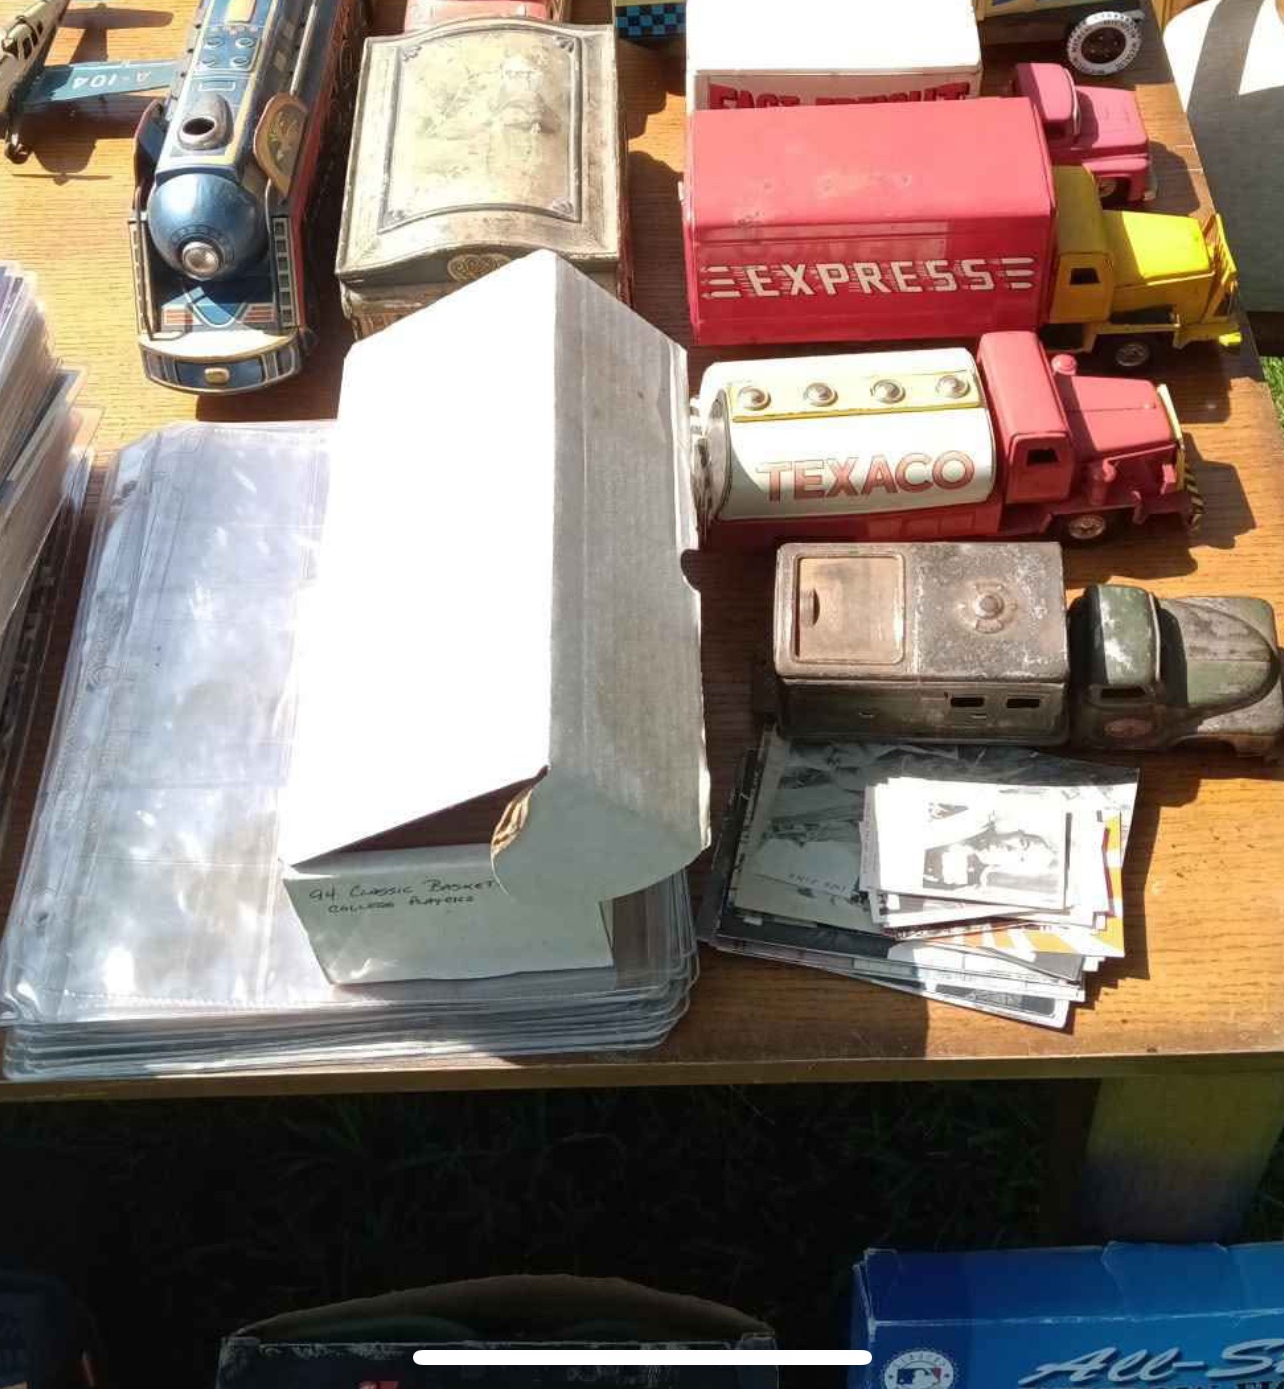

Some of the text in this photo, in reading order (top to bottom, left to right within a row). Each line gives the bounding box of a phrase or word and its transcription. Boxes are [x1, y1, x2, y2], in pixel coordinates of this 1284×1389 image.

[743, 258, 994, 298] EXPRESS
[757, 451, 975, 502] TEXACO
[1017, 1338, 1284, 1385] All-S
